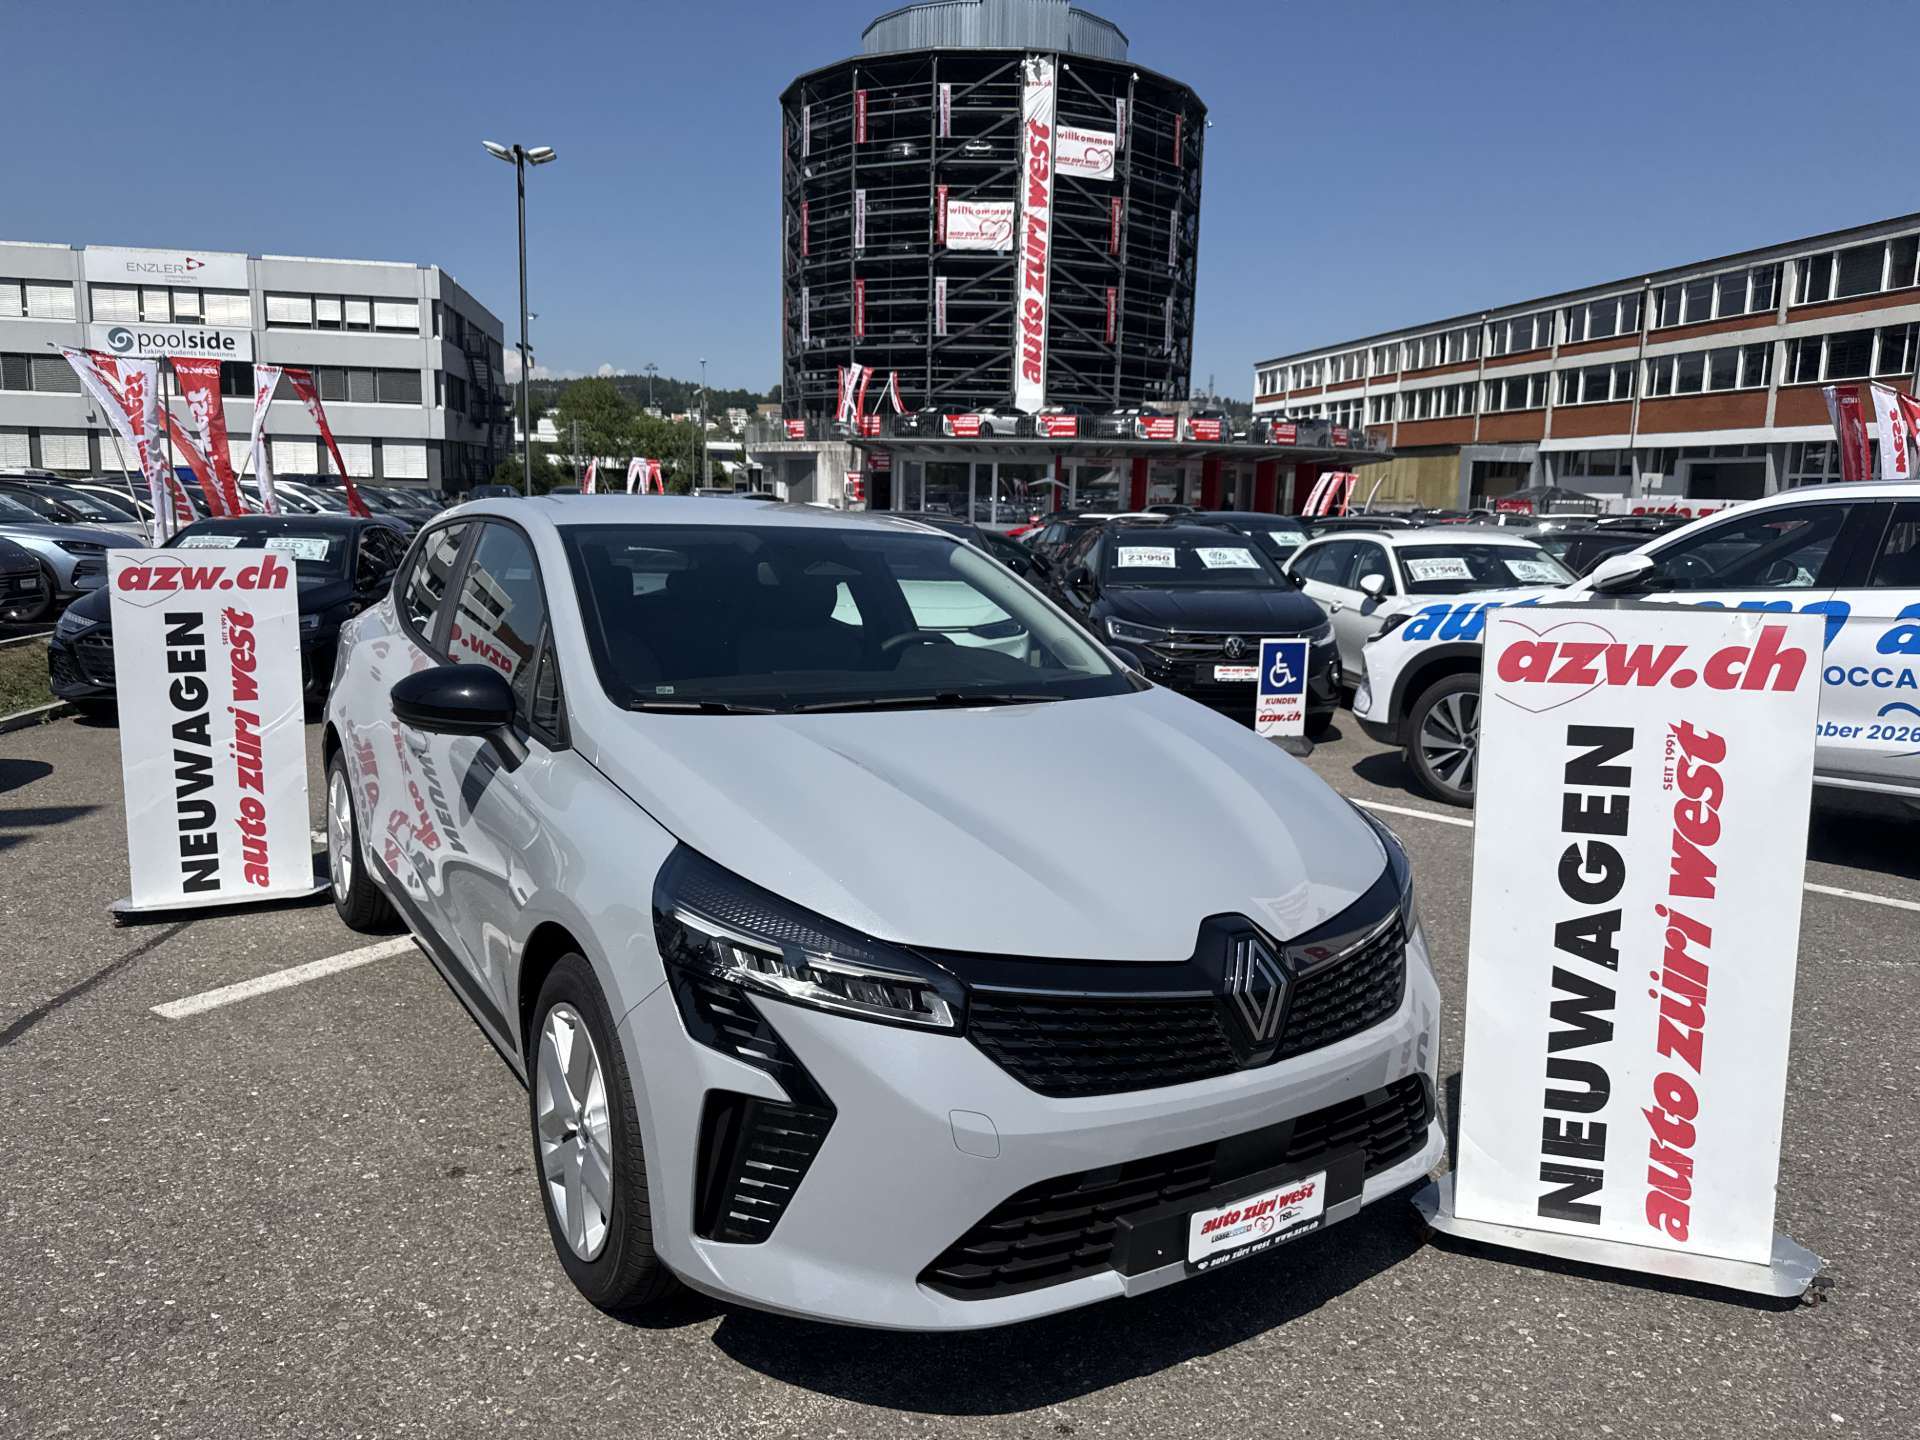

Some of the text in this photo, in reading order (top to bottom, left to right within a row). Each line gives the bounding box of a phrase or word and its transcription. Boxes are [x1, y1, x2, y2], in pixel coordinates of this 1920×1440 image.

[1057, 131, 1114, 146] willkommen
[949, 205, 1012, 215] willkommen
[1021, 118, 1050, 385] auto züri west
[126, 262, 184, 274] ENZLER
[138, 330, 235, 353] poolside
[118, 555, 289, 592] azw.ch
[1497, 624, 1807, 692] azw.ch
[1823, 666, 1918, 689] OCCA
[1259, 711, 1302, 722] azw.ch
[1265, 697, 1297, 705] KUNDEN
[222, 606, 270, 888] auto züri west
[1866, 725, 1920, 743] 2026
[164, 612, 221, 894] NEUWAGEN
[1663, 734, 1676, 791] SEIT 1991
[1538, 724, 1635, 1224] NEUWAGEN
[1643, 720, 1727, 1243] auto züri west
[1201, 1209, 1241, 1235] auto
[1241, 1195, 1280, 1222] züri
[1279, 1183, 1316, 1209] west
[1210, 1254, 1231, 1267] auto
[1232, 1246, 1250, 1259] züri
[1252, 1239, 1271, 1252] west
